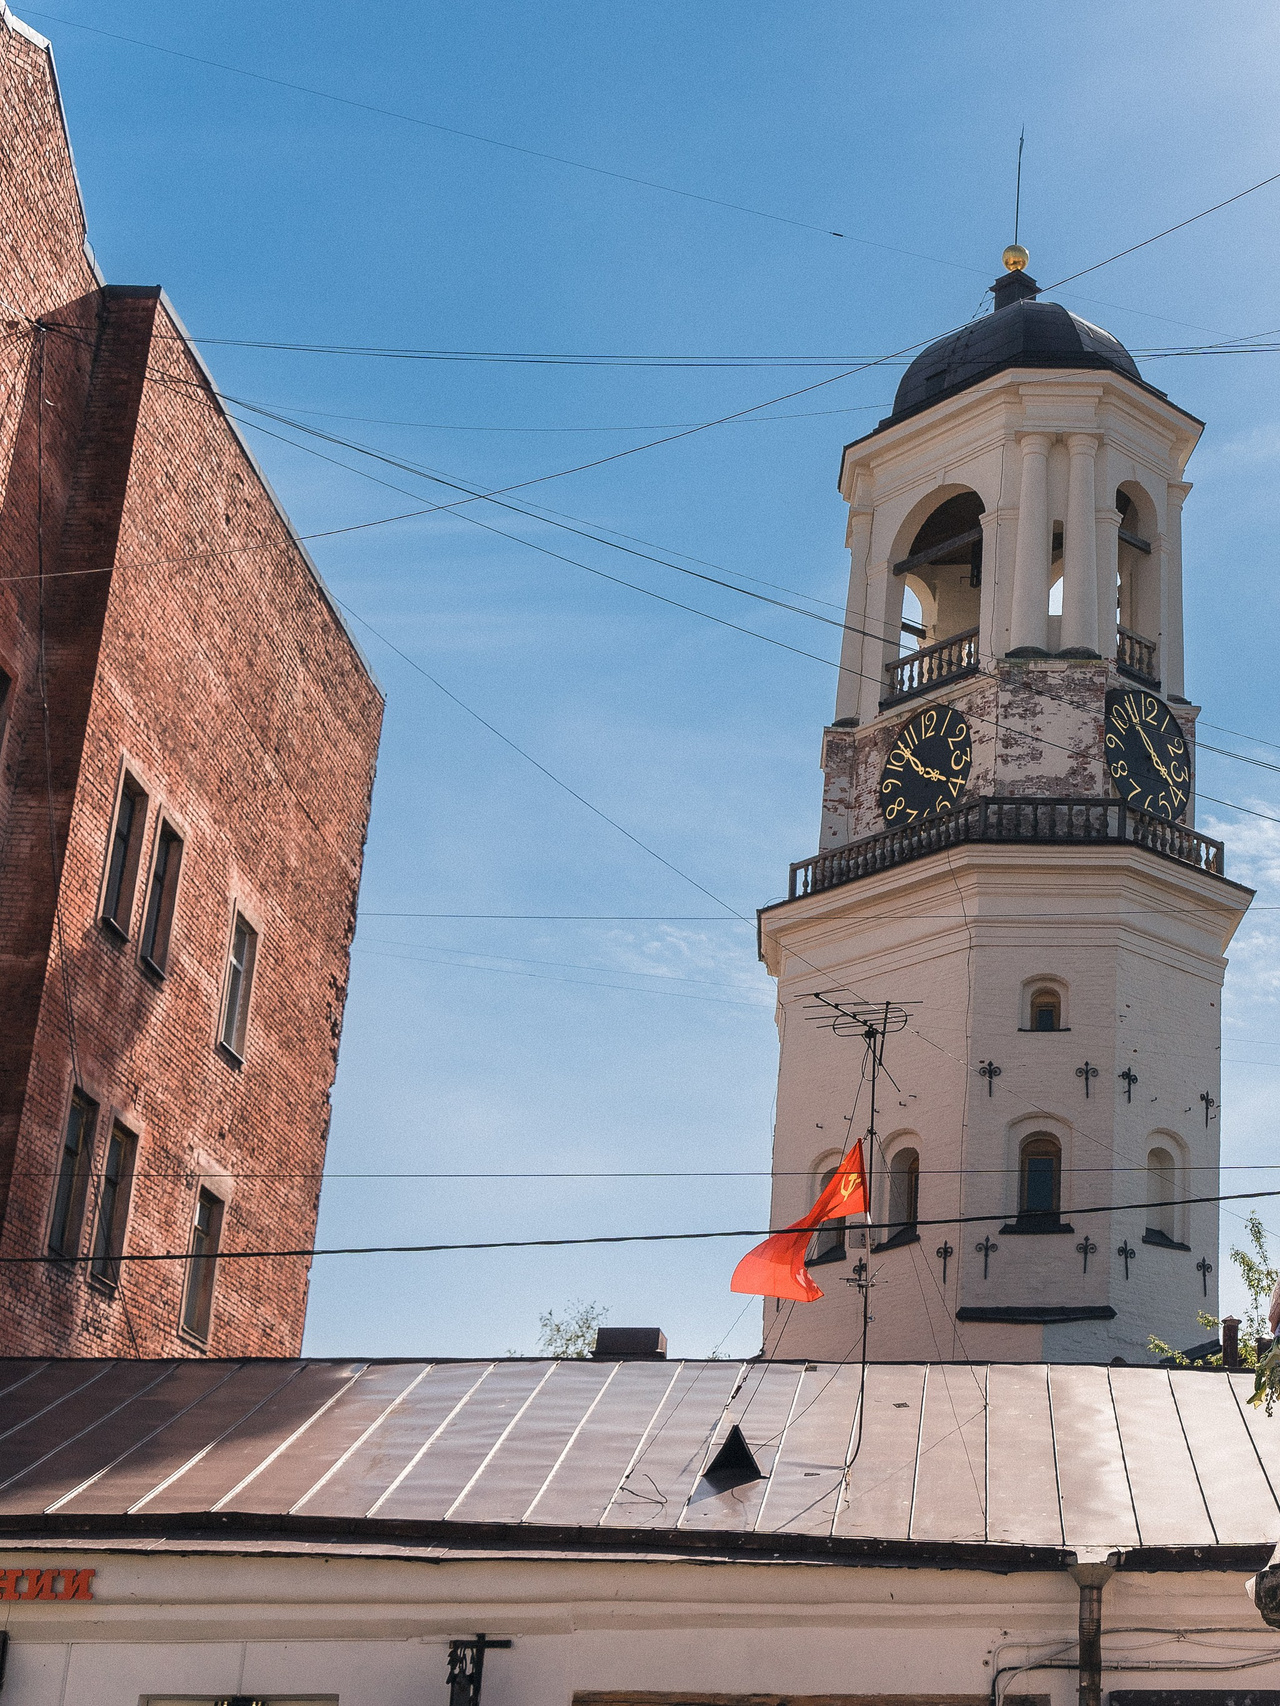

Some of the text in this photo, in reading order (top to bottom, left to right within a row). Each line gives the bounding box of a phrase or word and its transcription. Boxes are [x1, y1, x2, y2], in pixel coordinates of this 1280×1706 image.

[1110, 705, 1129, 735] 10
[1142, 693, 1158, 725] 12
[921, 711, 937, 740] 12
[940, 710, 952, 736] 1
[1161, 715, 1170, 733] 1
[904, 725, 919, 749] 11
[948, 724, 967, 750] 2
[1106, 734, 1125, 751] 9
[1167, 738, 1184, 756] 2
[887, 750, 908, 771] 10
[951, 748, 971, 771] 3
[1111, 761, 1128, 778] 8
[1171, 761, 1189, 782] 3
[882, 779, 902, 794] 9
[948, 775, 966, 798] 4
[1128, 778, 1142, 801] 7
[1170, 786, 1187, 807] 4
[886, 797, 905, 820] 8
[1159, 792, 1172, 820] 5
